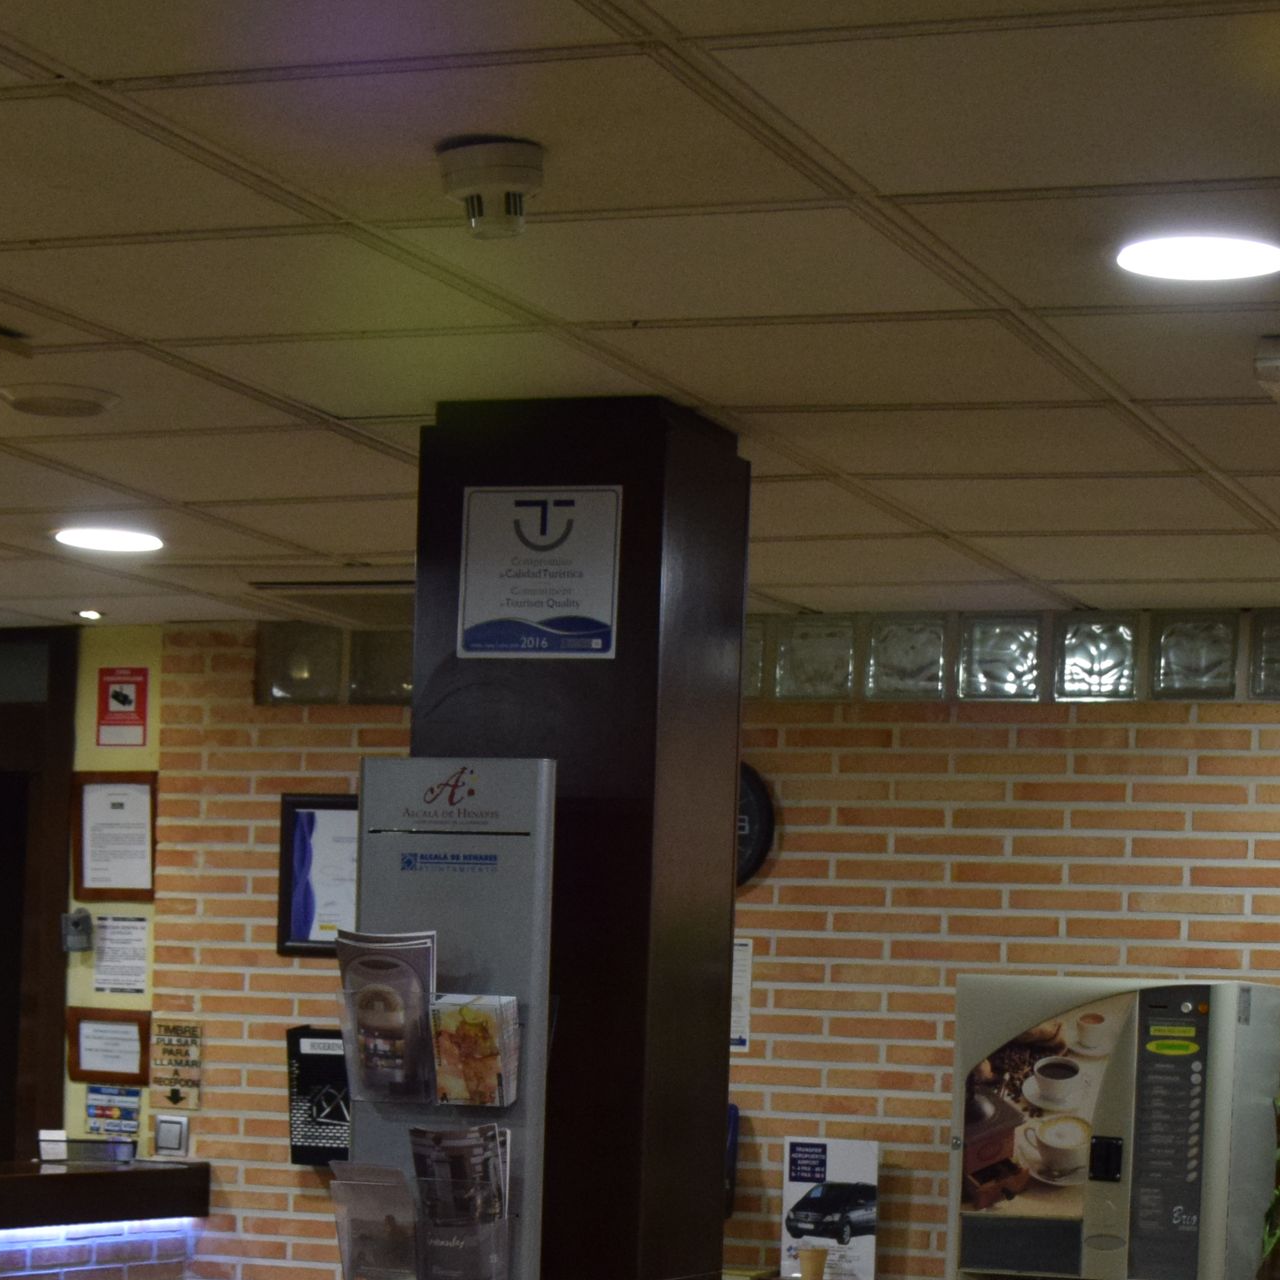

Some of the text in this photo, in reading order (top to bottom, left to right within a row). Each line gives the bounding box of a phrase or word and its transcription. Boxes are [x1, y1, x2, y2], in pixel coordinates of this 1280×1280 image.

[520, 636, 548, 648] 2016
[157, 1023, 200, 1036] TIMBRE
[162, 1047, 191, 1057] PARA
[154, 1058, 201, 1067] LLAMAR
[173, 1068, 180, 1077] A
